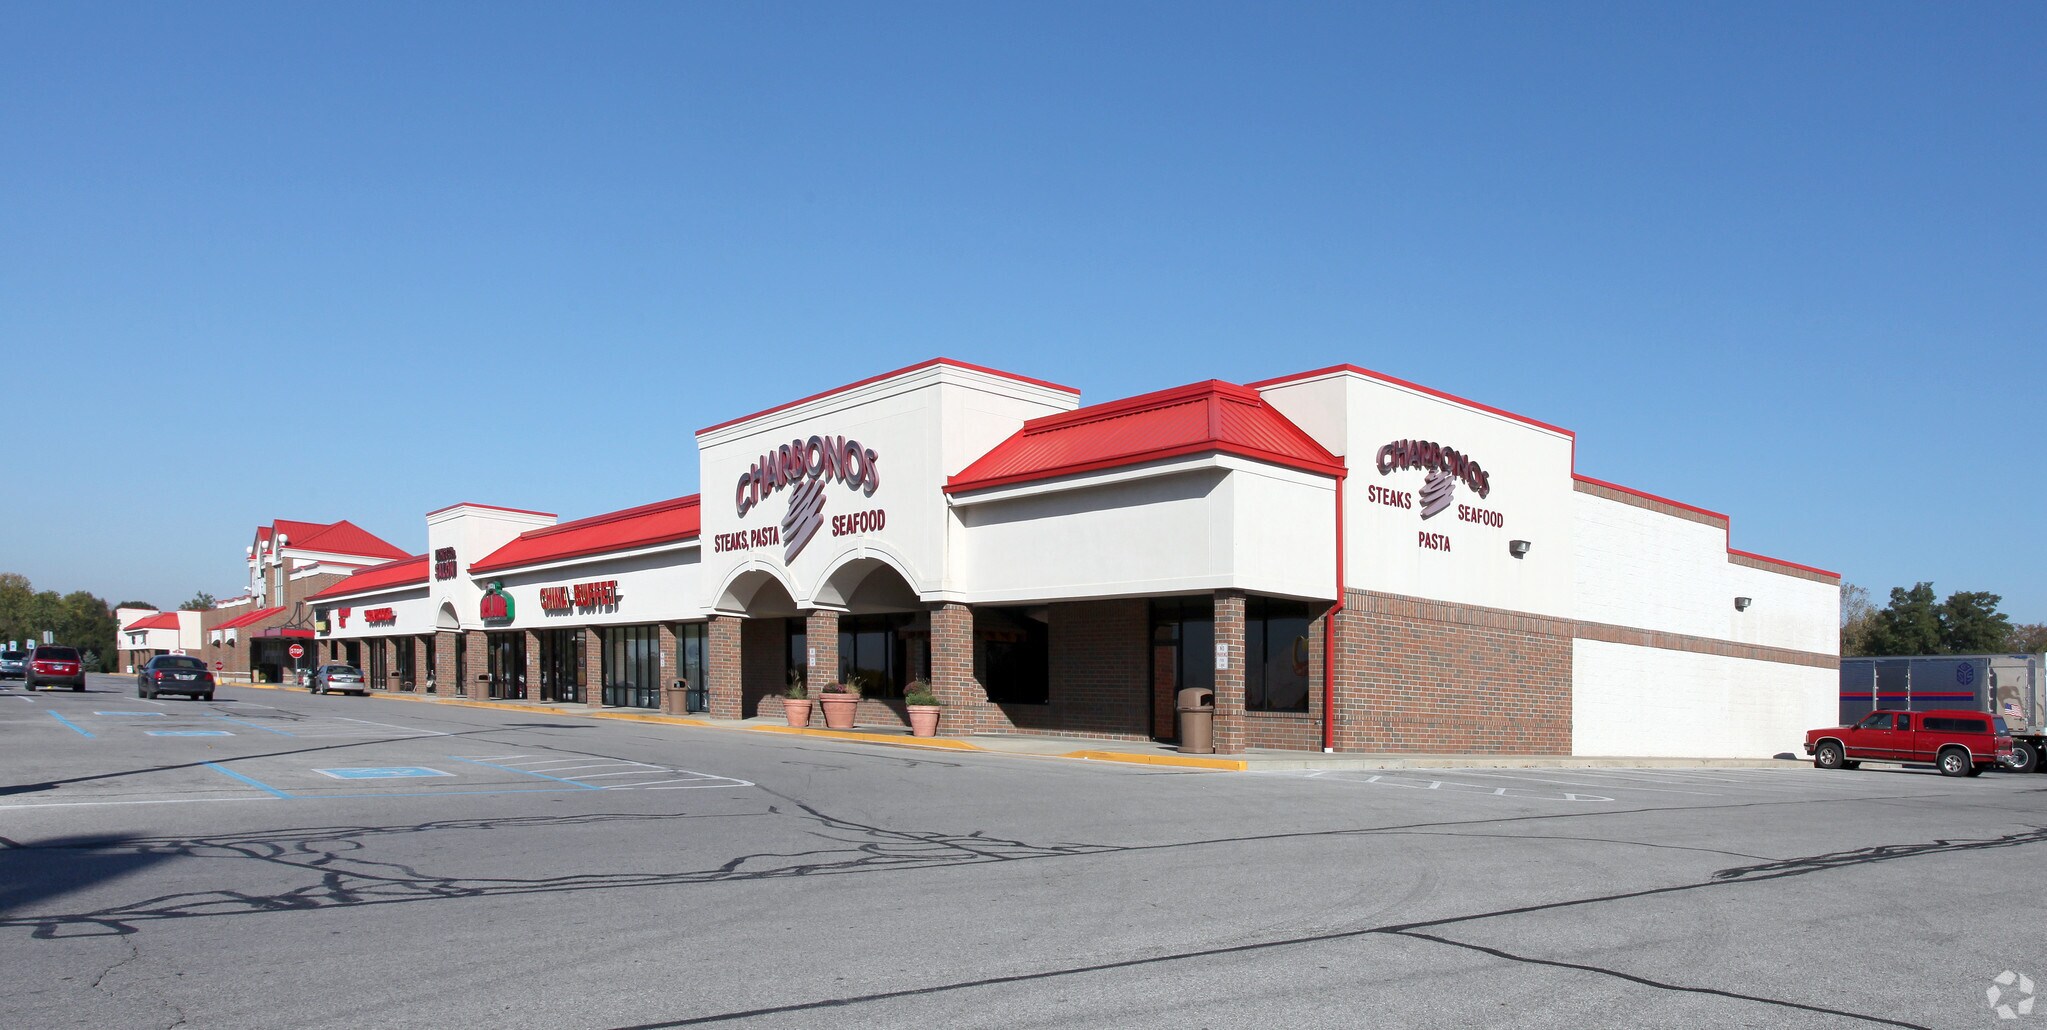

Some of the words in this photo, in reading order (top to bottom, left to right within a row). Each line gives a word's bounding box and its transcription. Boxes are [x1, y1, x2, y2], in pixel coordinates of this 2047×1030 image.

[735, 435, 880, 515] CHARBONOS
[1376, 438, 1491, 500] CHARBONOS
[1368, 484, 1412, 510] STEAKS
[832, 509, 886, 537] SEAFOOD
[1458, 503, 1504, 529] SEAFOOD
[714, 531, 750, 553] STEAKS,
[751, 526, 780, 548] PASTA
[1418, 531, 1451, 552] PASTA
[540, 586, 570, 610] CHINA
[574, 580, 618, 607] BUFFET
